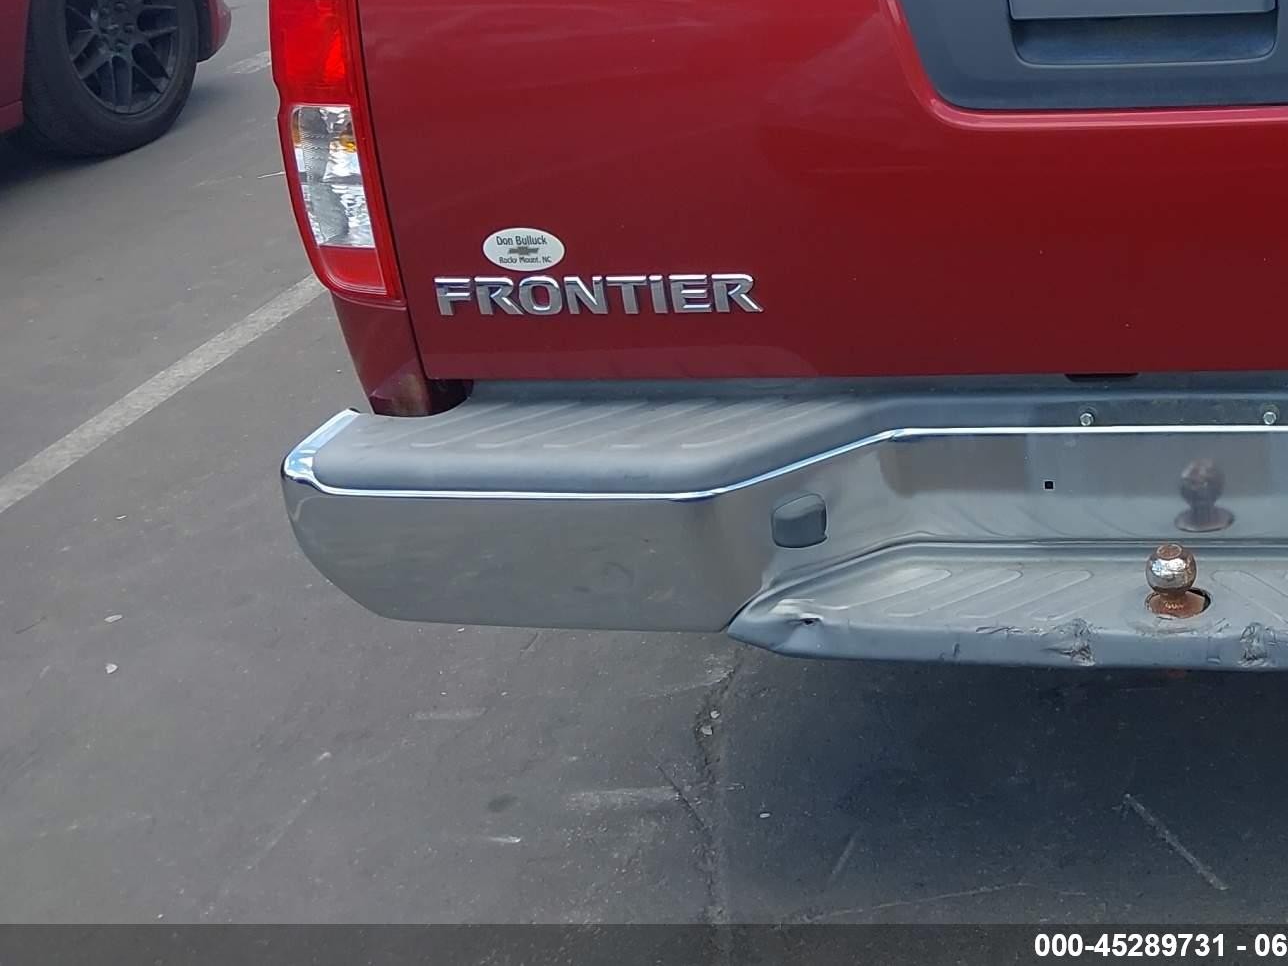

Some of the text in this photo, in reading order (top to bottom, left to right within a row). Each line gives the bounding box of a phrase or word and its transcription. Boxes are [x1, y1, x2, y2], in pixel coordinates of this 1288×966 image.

[496, 235, 548, 246] Don Bulluck
[499, 256, 517, 264] Rocky
[434, 274, 764, 316] FRONTIER
